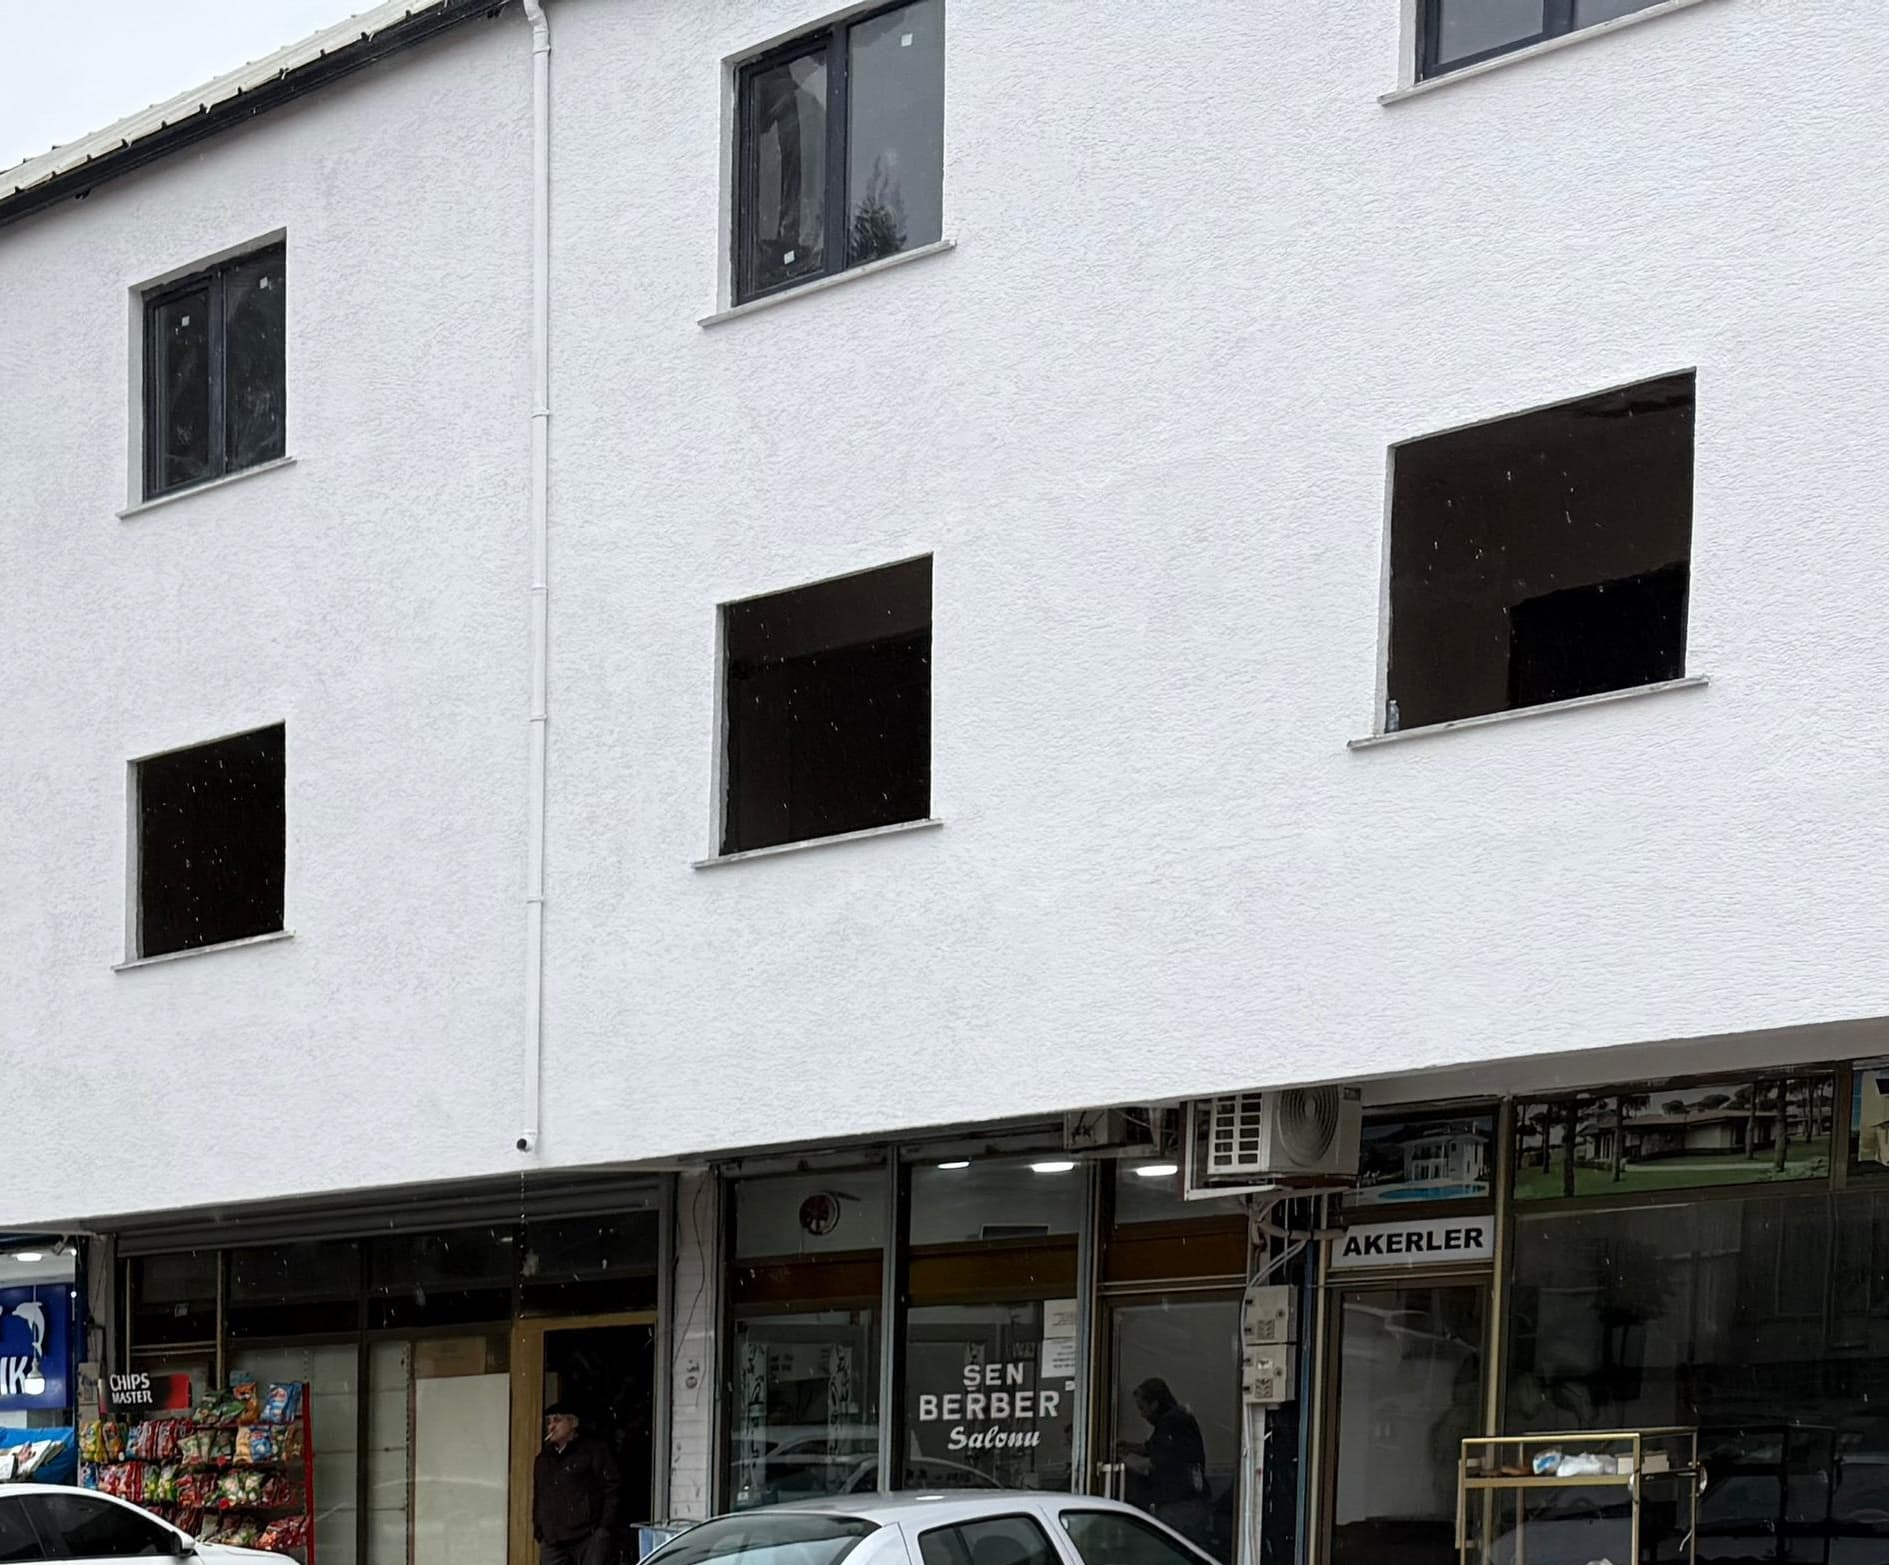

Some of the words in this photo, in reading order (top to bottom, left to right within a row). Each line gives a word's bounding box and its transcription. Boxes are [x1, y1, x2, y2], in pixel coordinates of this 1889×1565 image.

[1342, 1228, 1484, 1257] AKERLER
[110, 1373, 151, 1391] CHIPS
[962, 1362, 1024, 1391] ŞEN
[112, 1390, 153, 1404] MASTER
[919, 1391, 1060, 1421] BERBER
[947, 1425, 1040, 1450] Salonu
